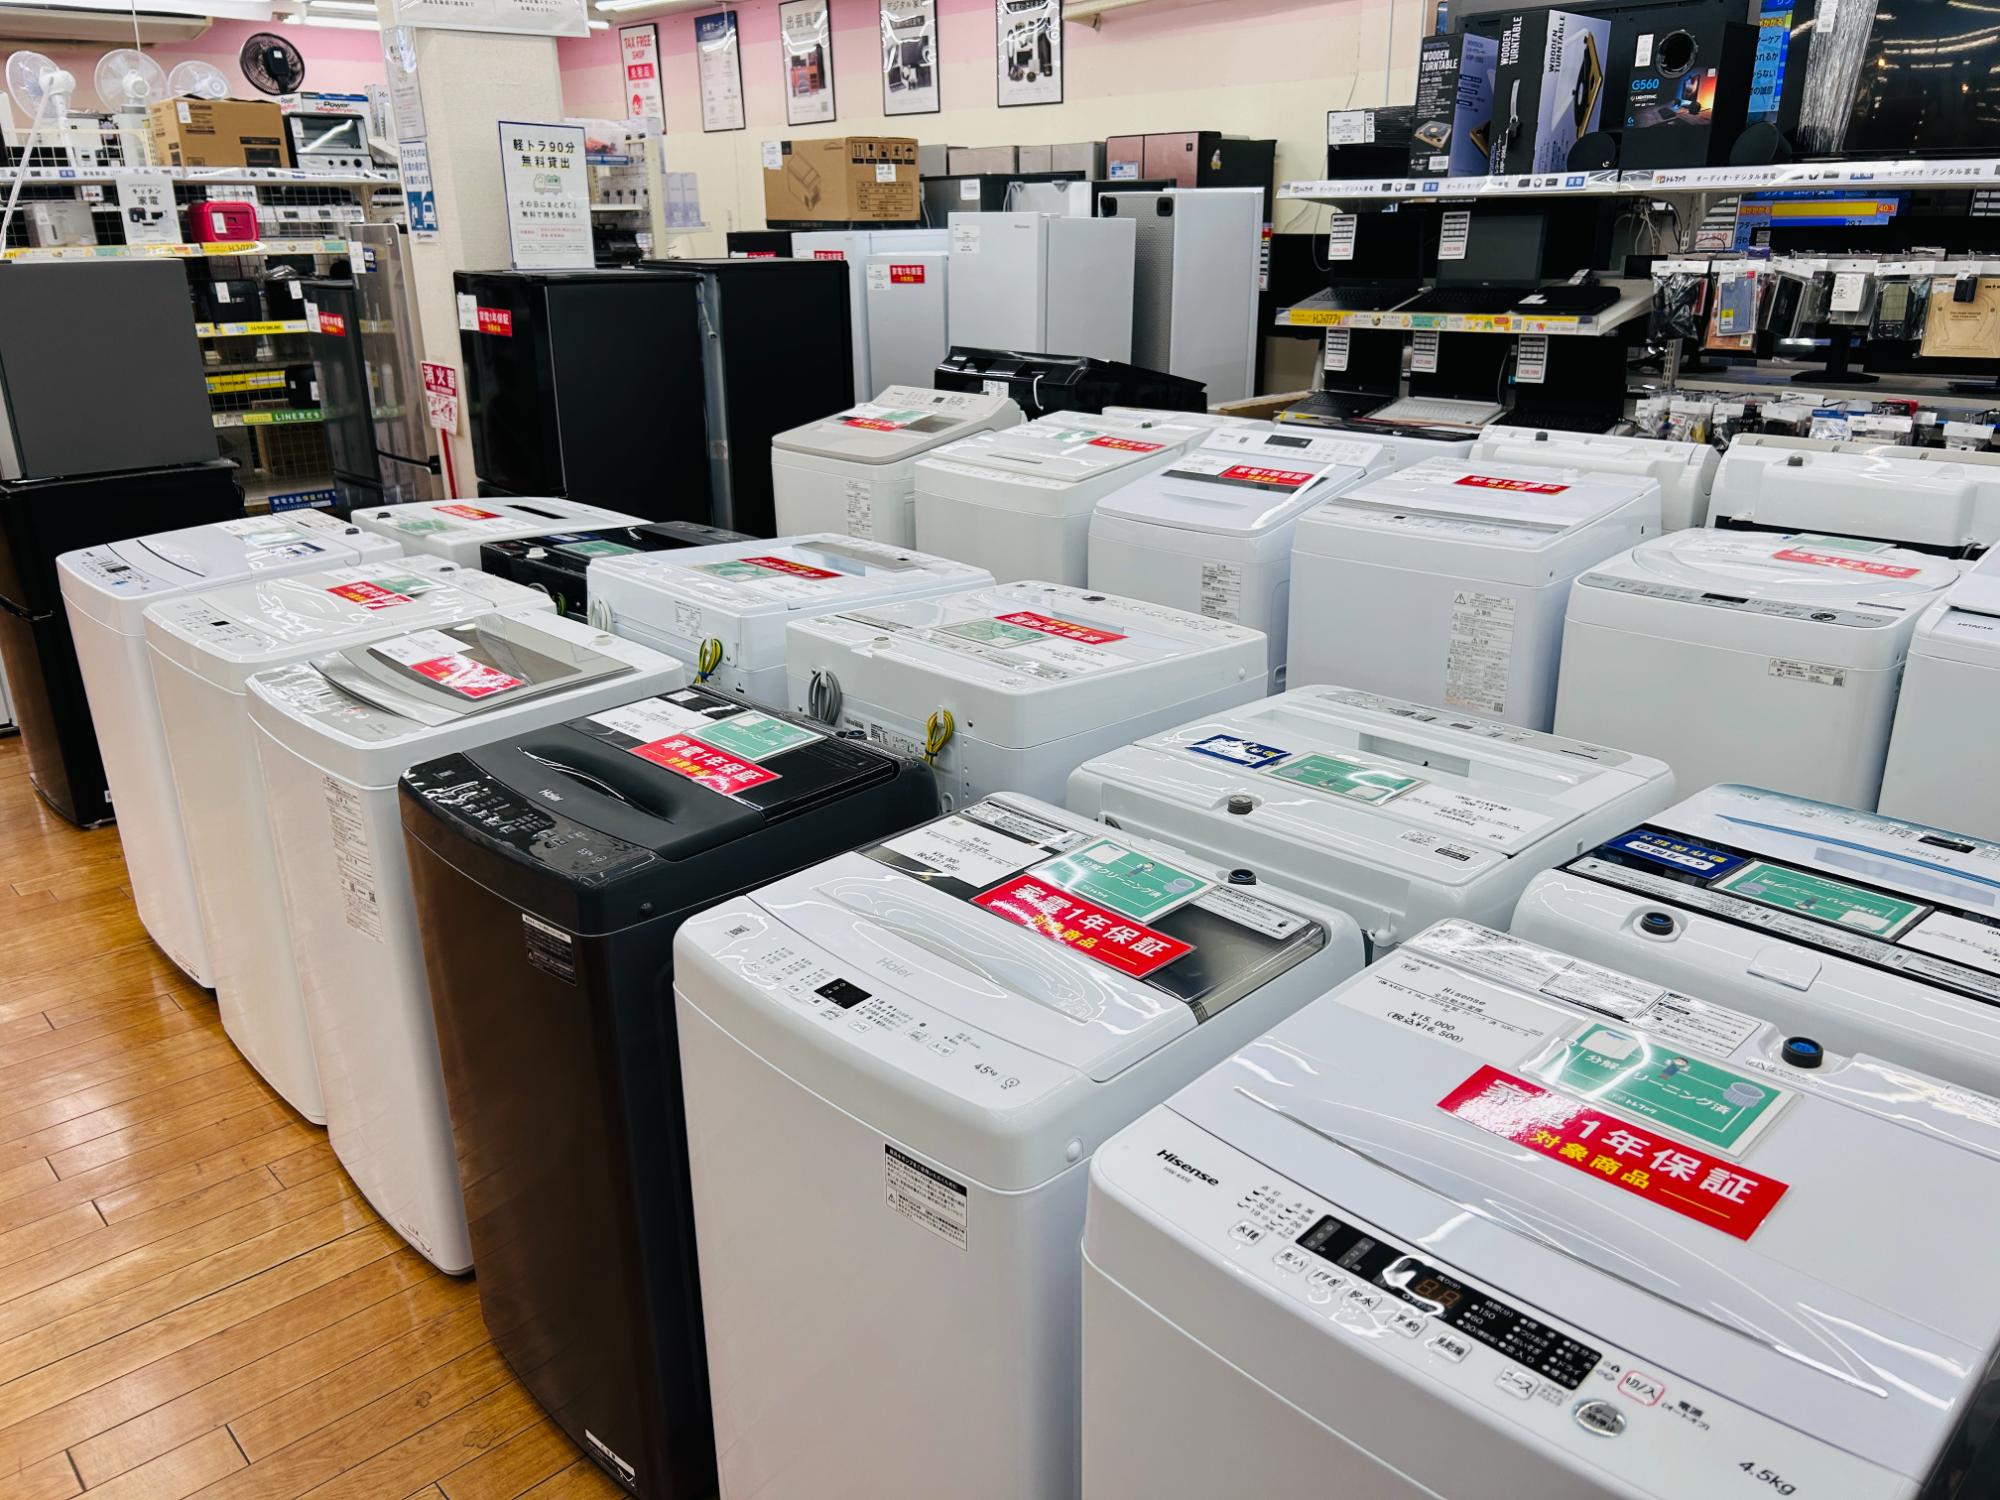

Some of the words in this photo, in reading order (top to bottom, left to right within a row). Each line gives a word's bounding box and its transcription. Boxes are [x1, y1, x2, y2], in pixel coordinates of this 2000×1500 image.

[624, 37, 635, 49] TAX
[636, 34, 651, 47] FREE
[1500, 30, 1512, 66] WOODEN
[1509, 16, 1522, 66] TURNTABLE
[1548, 29, 1558, 73] WOODEN
[1554, 15, 1566, 73] TURNTABLE
[1421, 58, 1459, 72] TURNTABLE
[1423, 49, 1450, 61] WOODEN
[1631, 78, 1660, 91] G560
[513, 139, 576, 154] 軽トラ90分
[521, 155, 571, 169] 無料貸出
[424, 364, 456, 389] 消火器
[662, 738, 765, 784] 家電1年保証
[538, 788, 564, 802] Haier
[1011, 883, 1173, 958] 家電1年保証
[876, 956, 911, 978] Haier
[1442, 987, 1487, 1006] Hisense
[1156, 1149, 1220, 1187] Hisense
[1530, 1129, 1652, 1190] 対象商品
[1470, 1314, 1484, 1325] 60
[1478, 1306, 1496, 1321] 150
[1625, 1376, 1656, 1400] 切/入
[1738, 1460, 1797, 1497] 4.5kg
